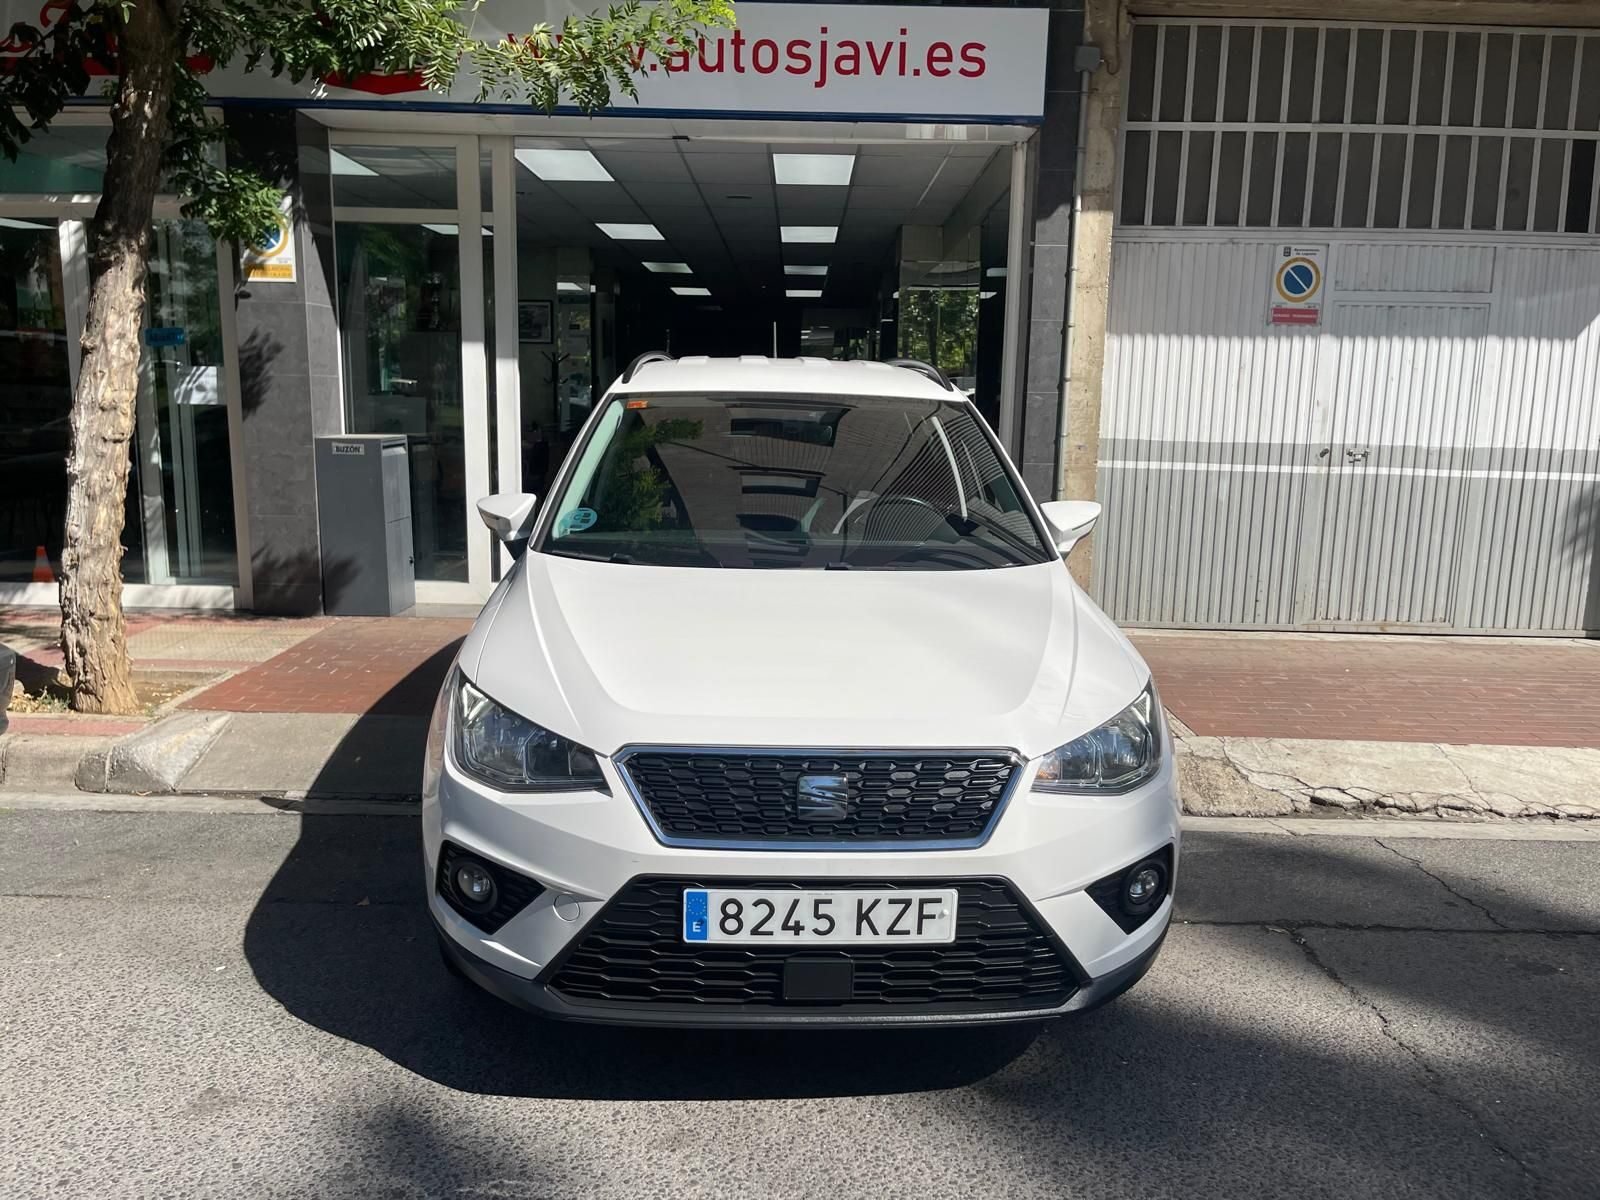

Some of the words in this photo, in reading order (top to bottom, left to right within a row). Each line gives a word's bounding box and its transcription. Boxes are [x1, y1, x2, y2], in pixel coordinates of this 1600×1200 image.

[507, 26, 987, 89] w.autosjavi.es
[692, 921, 702, 933] E
[718, 897, 836, 937] 8245
[855, 897, 943, 936] KZF
